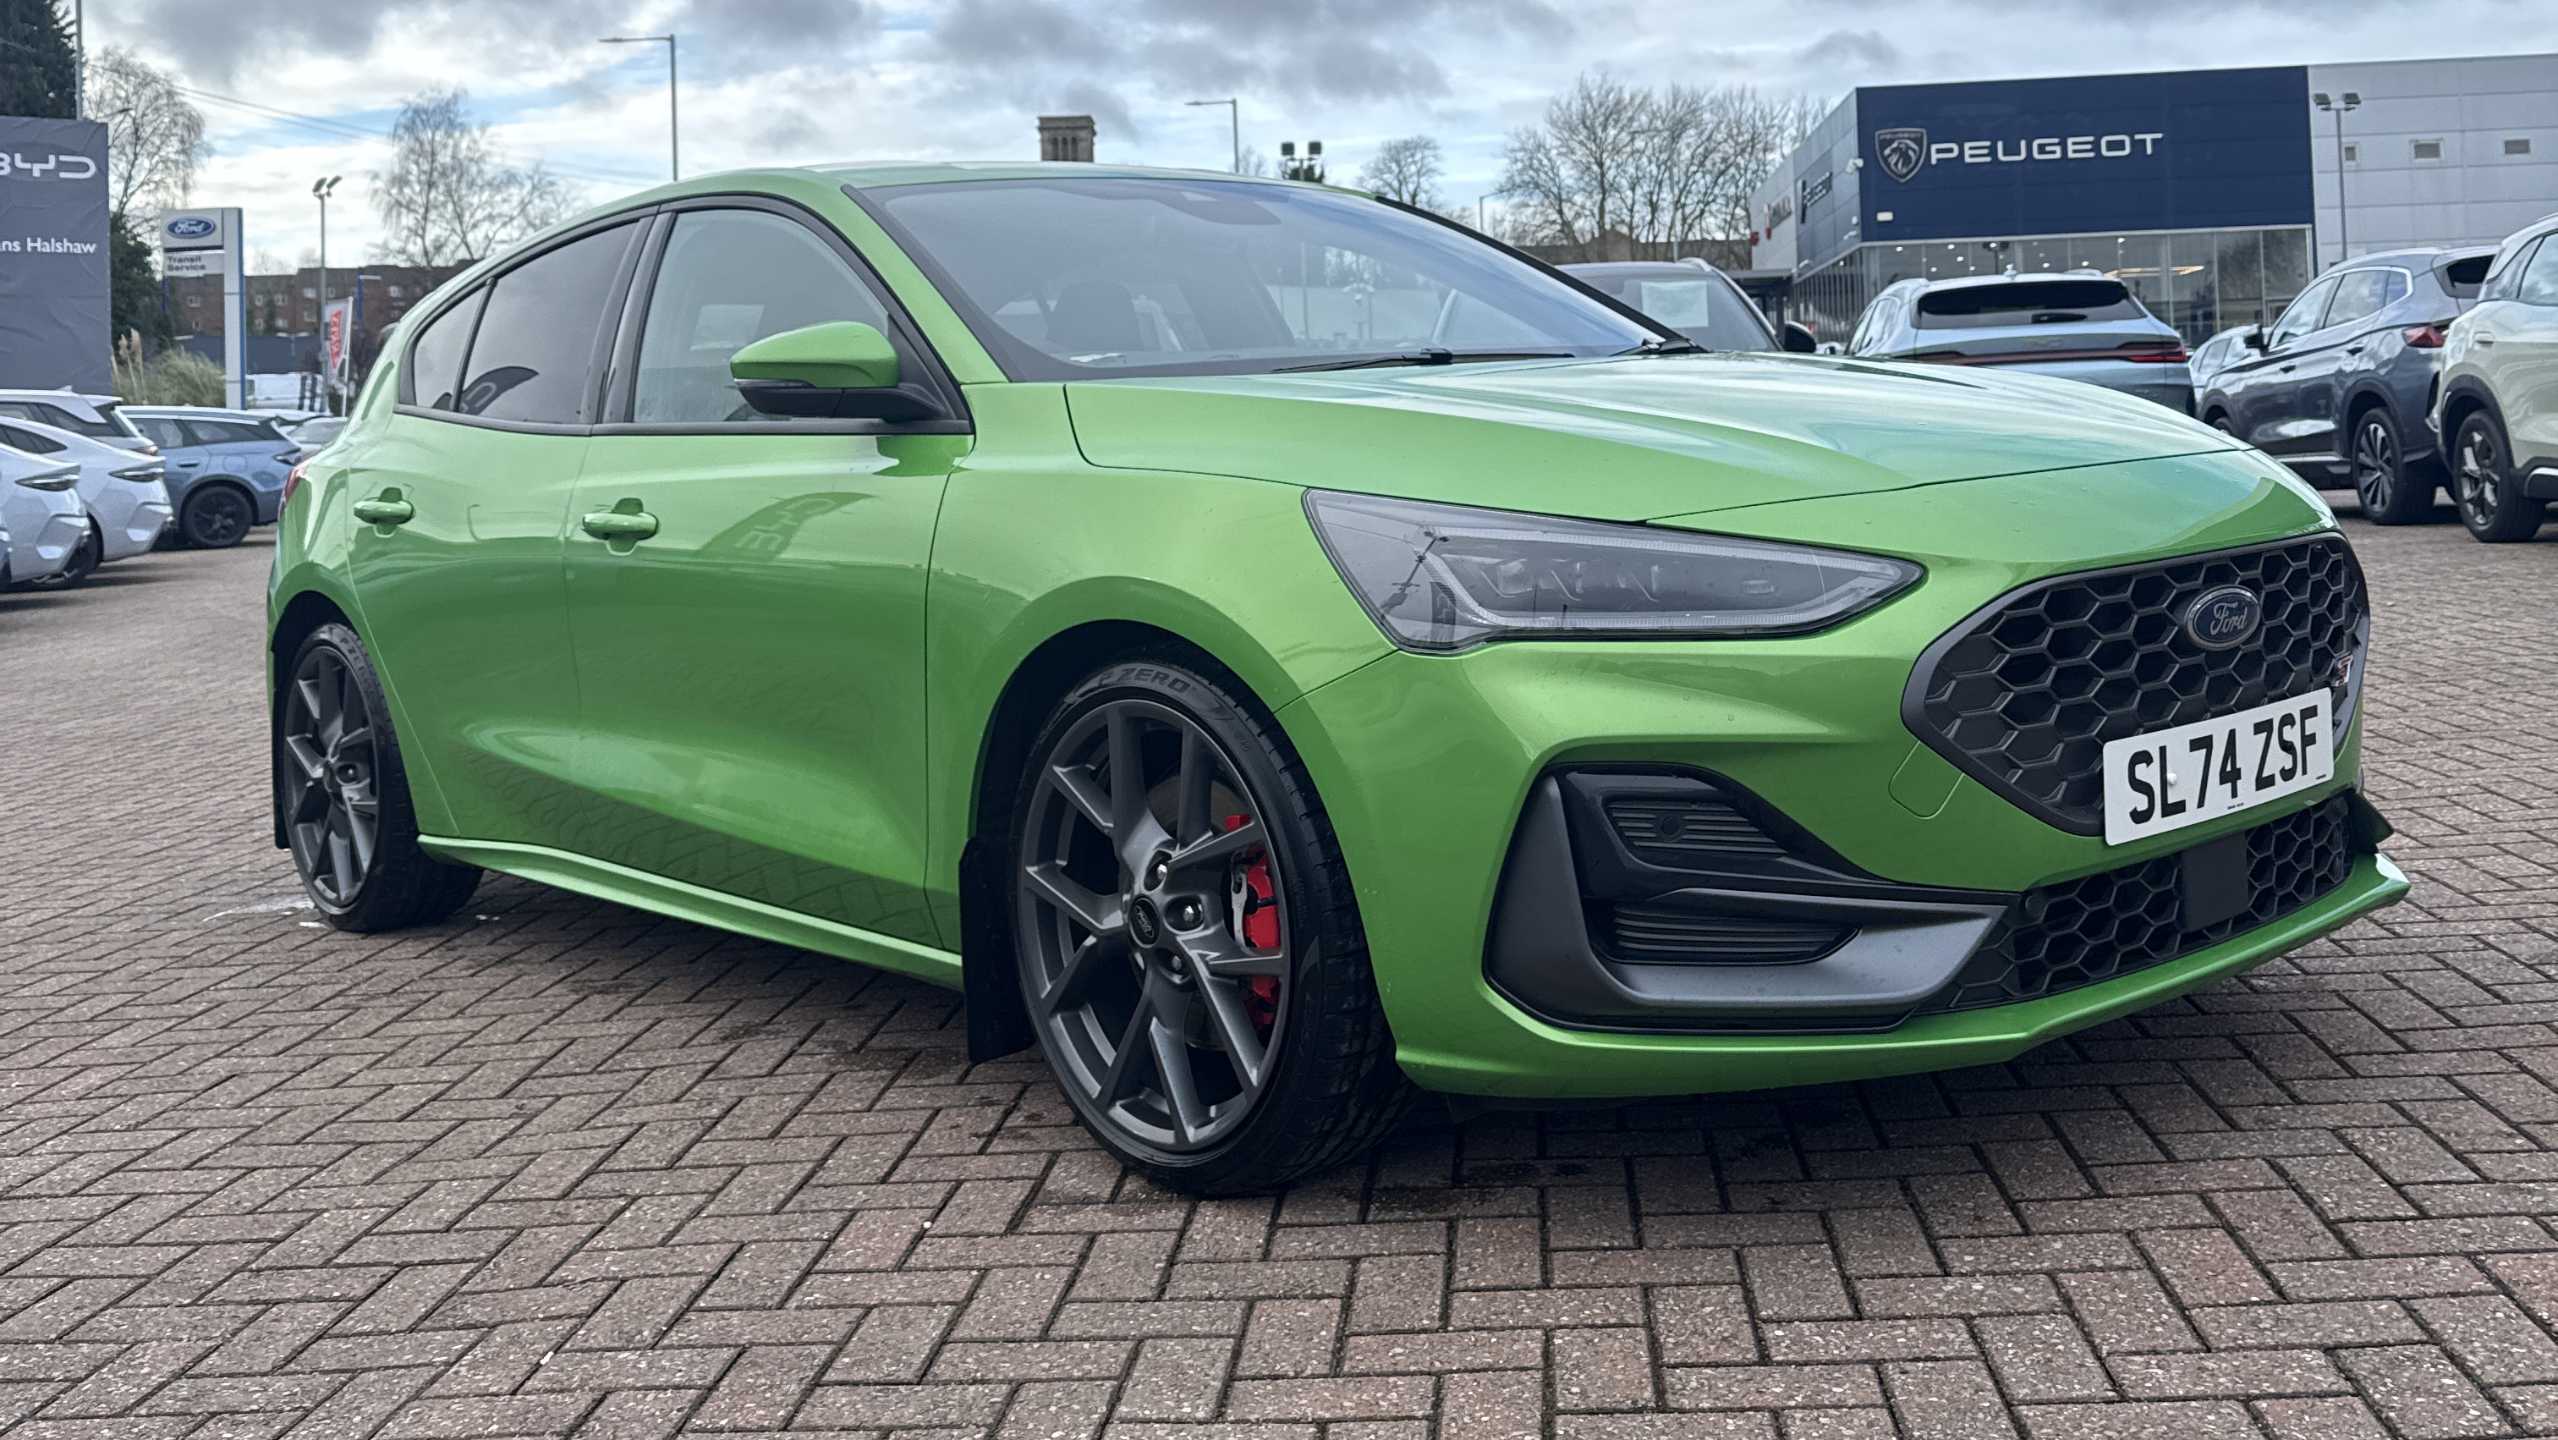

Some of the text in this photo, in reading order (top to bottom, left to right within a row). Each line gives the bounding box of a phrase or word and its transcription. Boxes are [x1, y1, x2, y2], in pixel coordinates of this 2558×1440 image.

[1930, 133, 2164, 165] PEUGEOT
[174, 220, 206, 233] Ford
[0, 237, 97, 253] ns Halshaw
[2209, 601, 2249, 636] Ford
[1116, 667, 1191, 694] ZERO
[2127, 704, 2319, 825] SL74 ZSF
